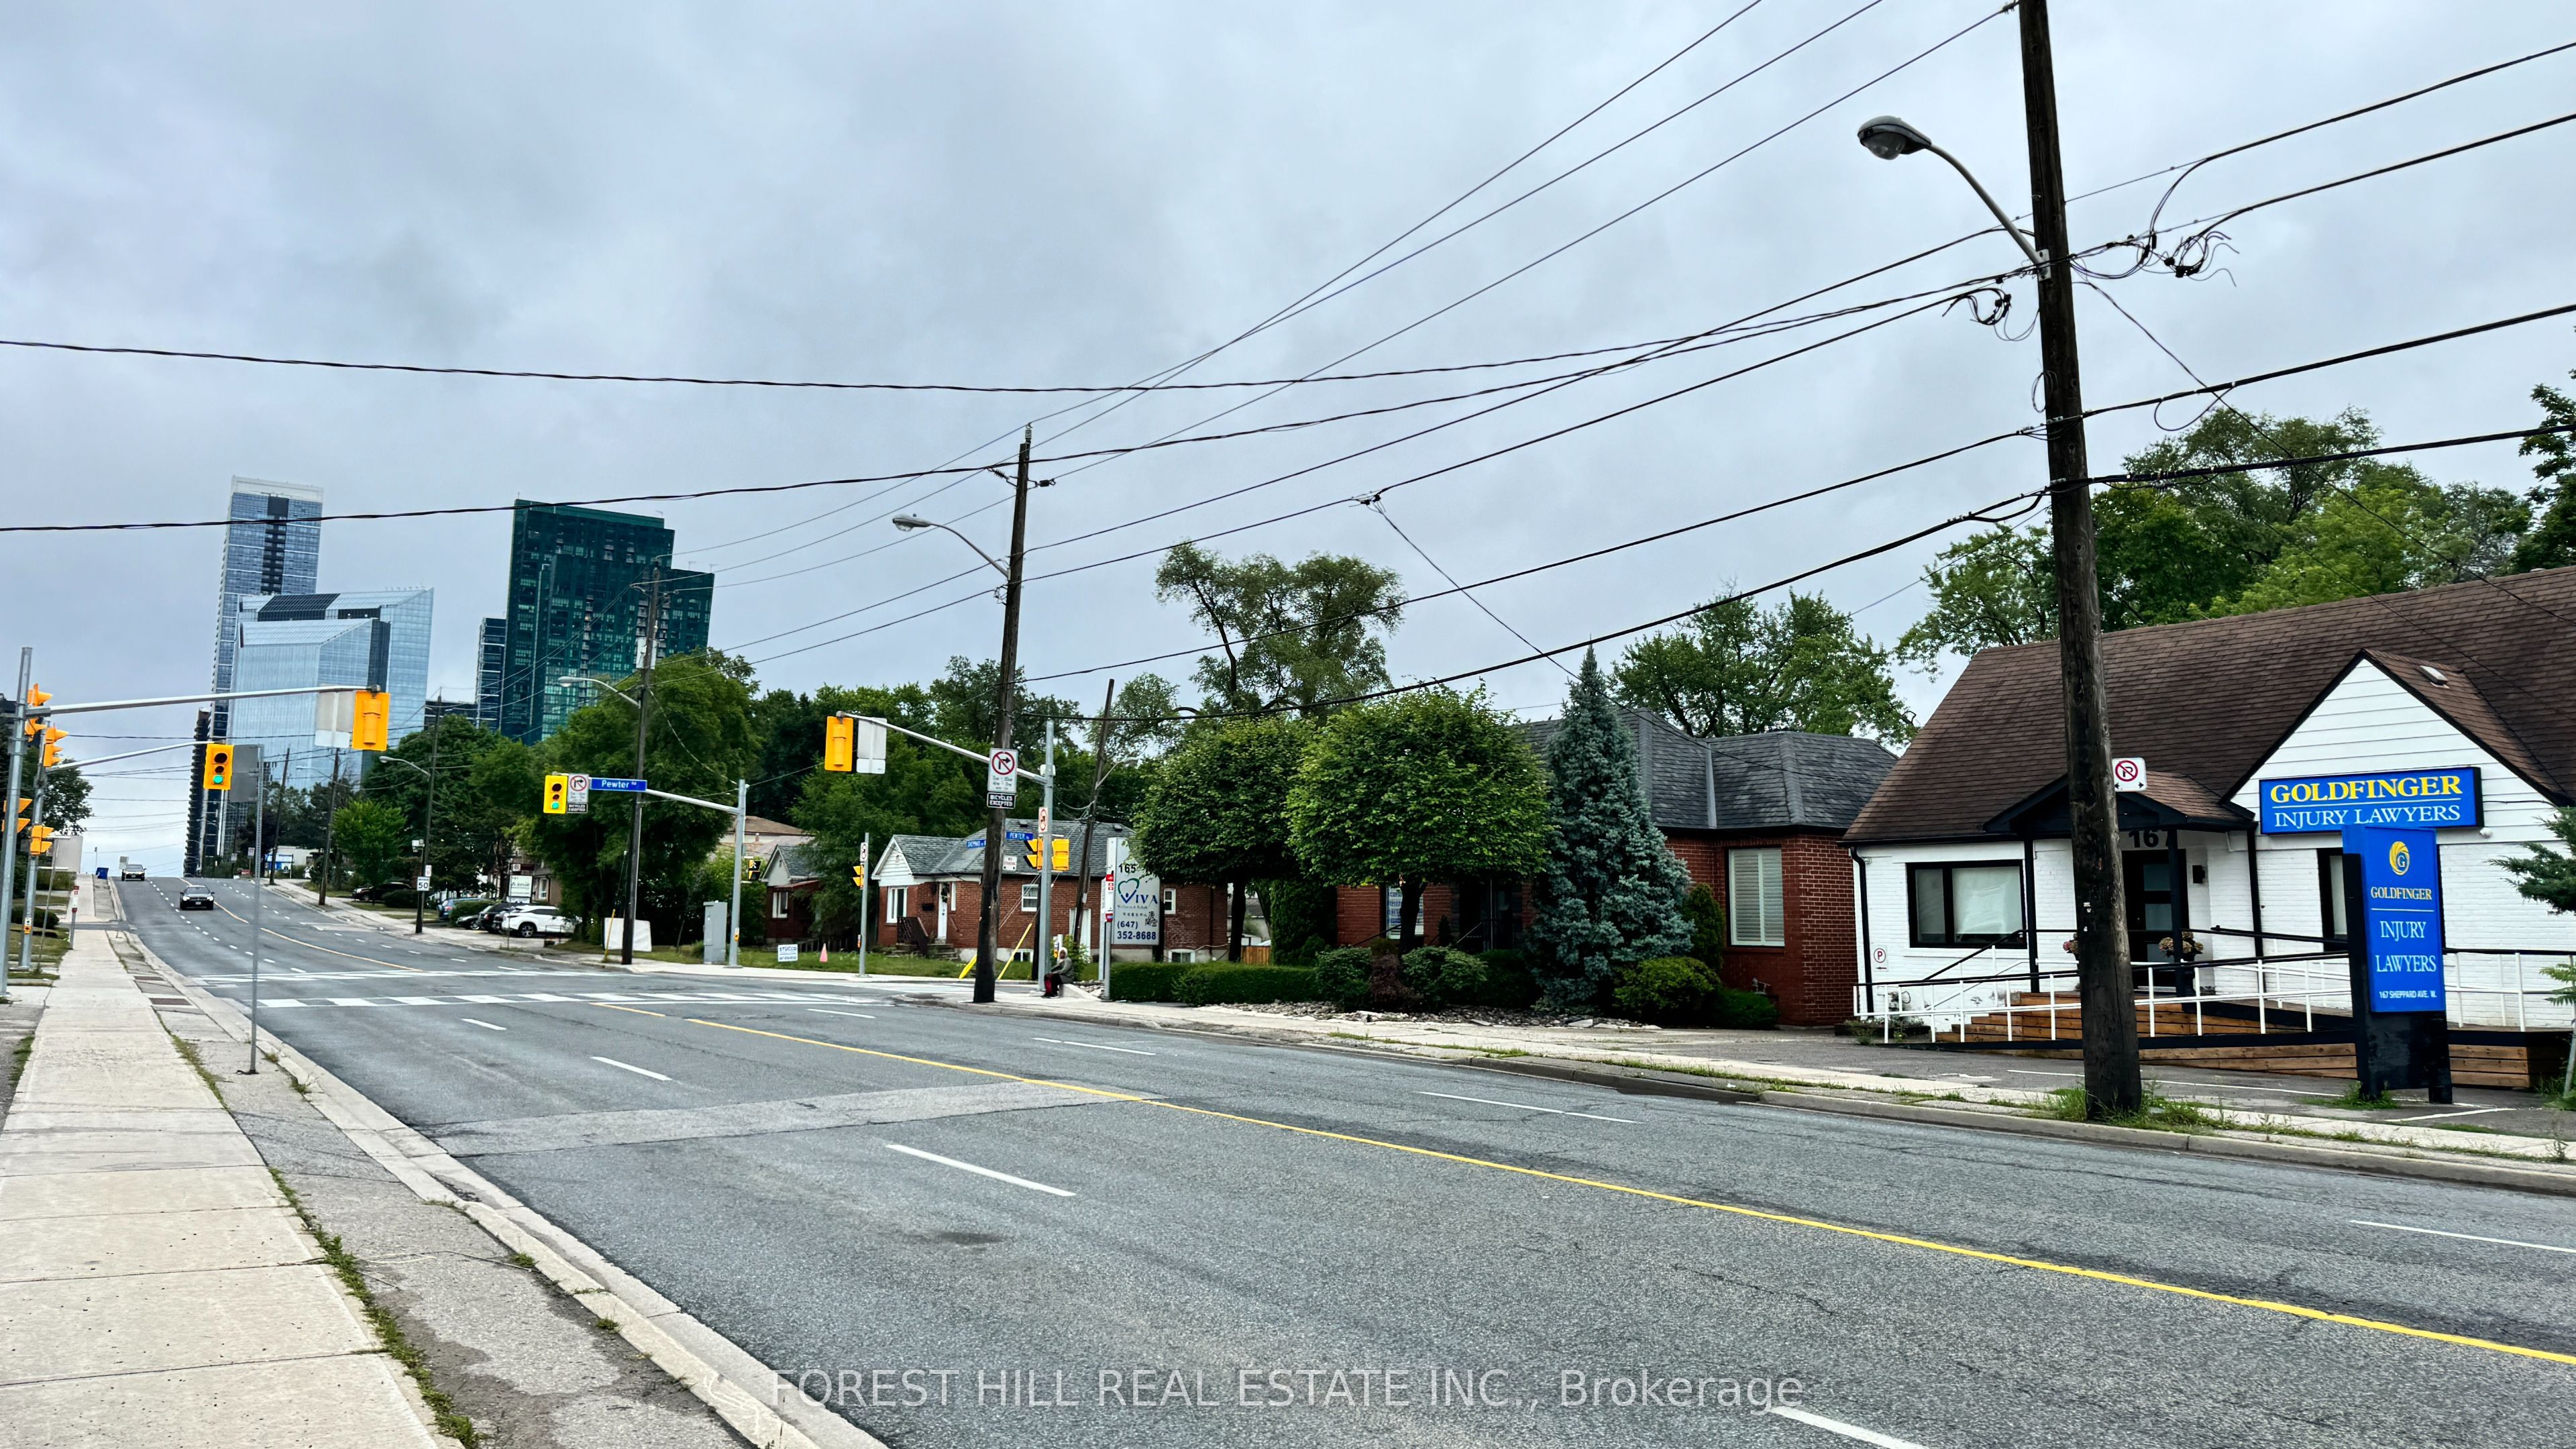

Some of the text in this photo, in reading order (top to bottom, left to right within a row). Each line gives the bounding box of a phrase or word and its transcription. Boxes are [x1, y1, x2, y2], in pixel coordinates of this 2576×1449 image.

[601, 780, 629, 789] Pewter
[2270, 775, 2463, 803] GOLDFINGER
[2274, 804, 2461, 829] INJURY LAWYERS
[1118, 863, 1136, 873] 165
[2370, 886, 2432, 900] GOLDFINGER
[1117, 920, 1138, 930] (647)
[2379, 920, 2426, 942] INJURY
[1117, 930, 1157, 940] 352-8688
[2375, 955, 2437, 973] LAWYERS
[2378, 990, 2388, 999] 167
[2389, 990, 2417, 999] SHEPPARD
